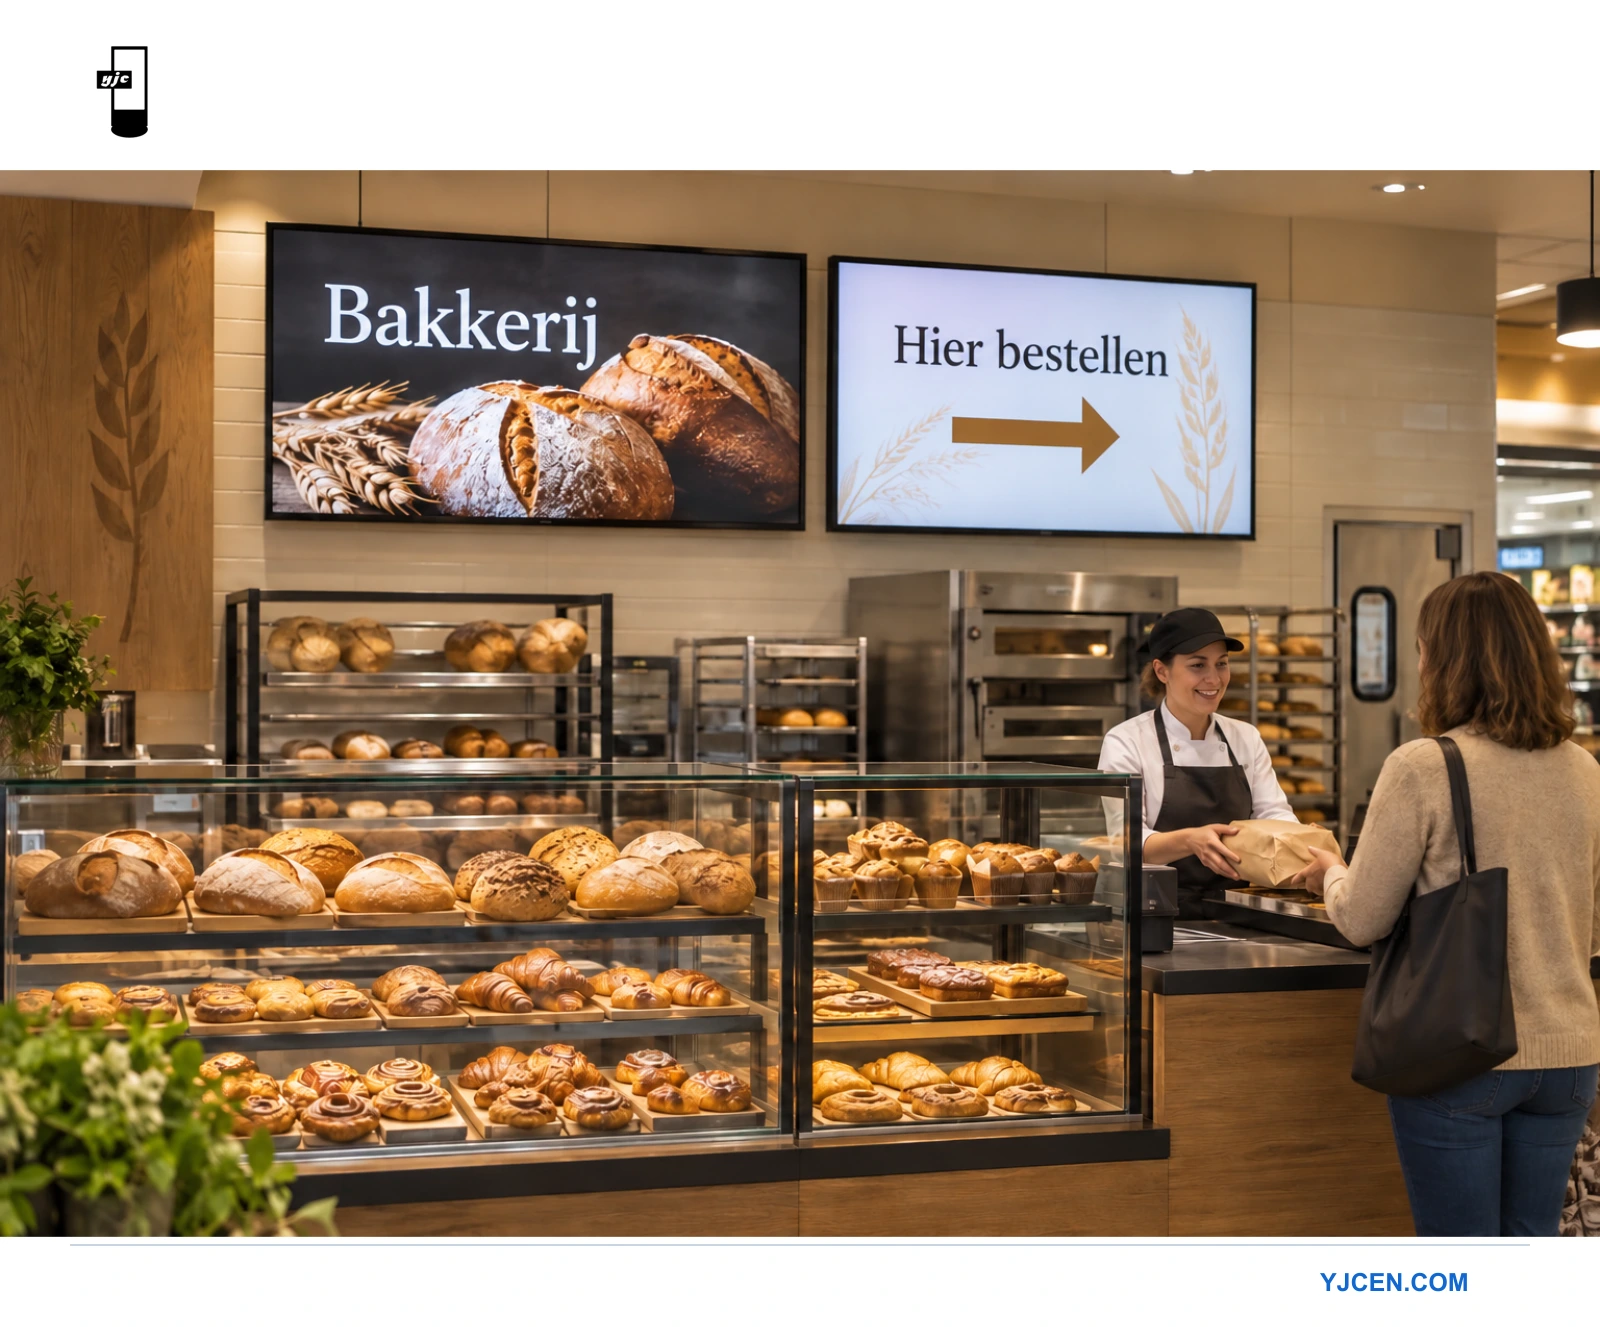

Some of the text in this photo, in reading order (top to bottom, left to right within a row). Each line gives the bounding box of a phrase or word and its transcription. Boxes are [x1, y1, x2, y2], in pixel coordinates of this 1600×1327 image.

[324, 283, 598, 371] Bakkerij
[894, 325, 1168, 377] Hier bestellen
